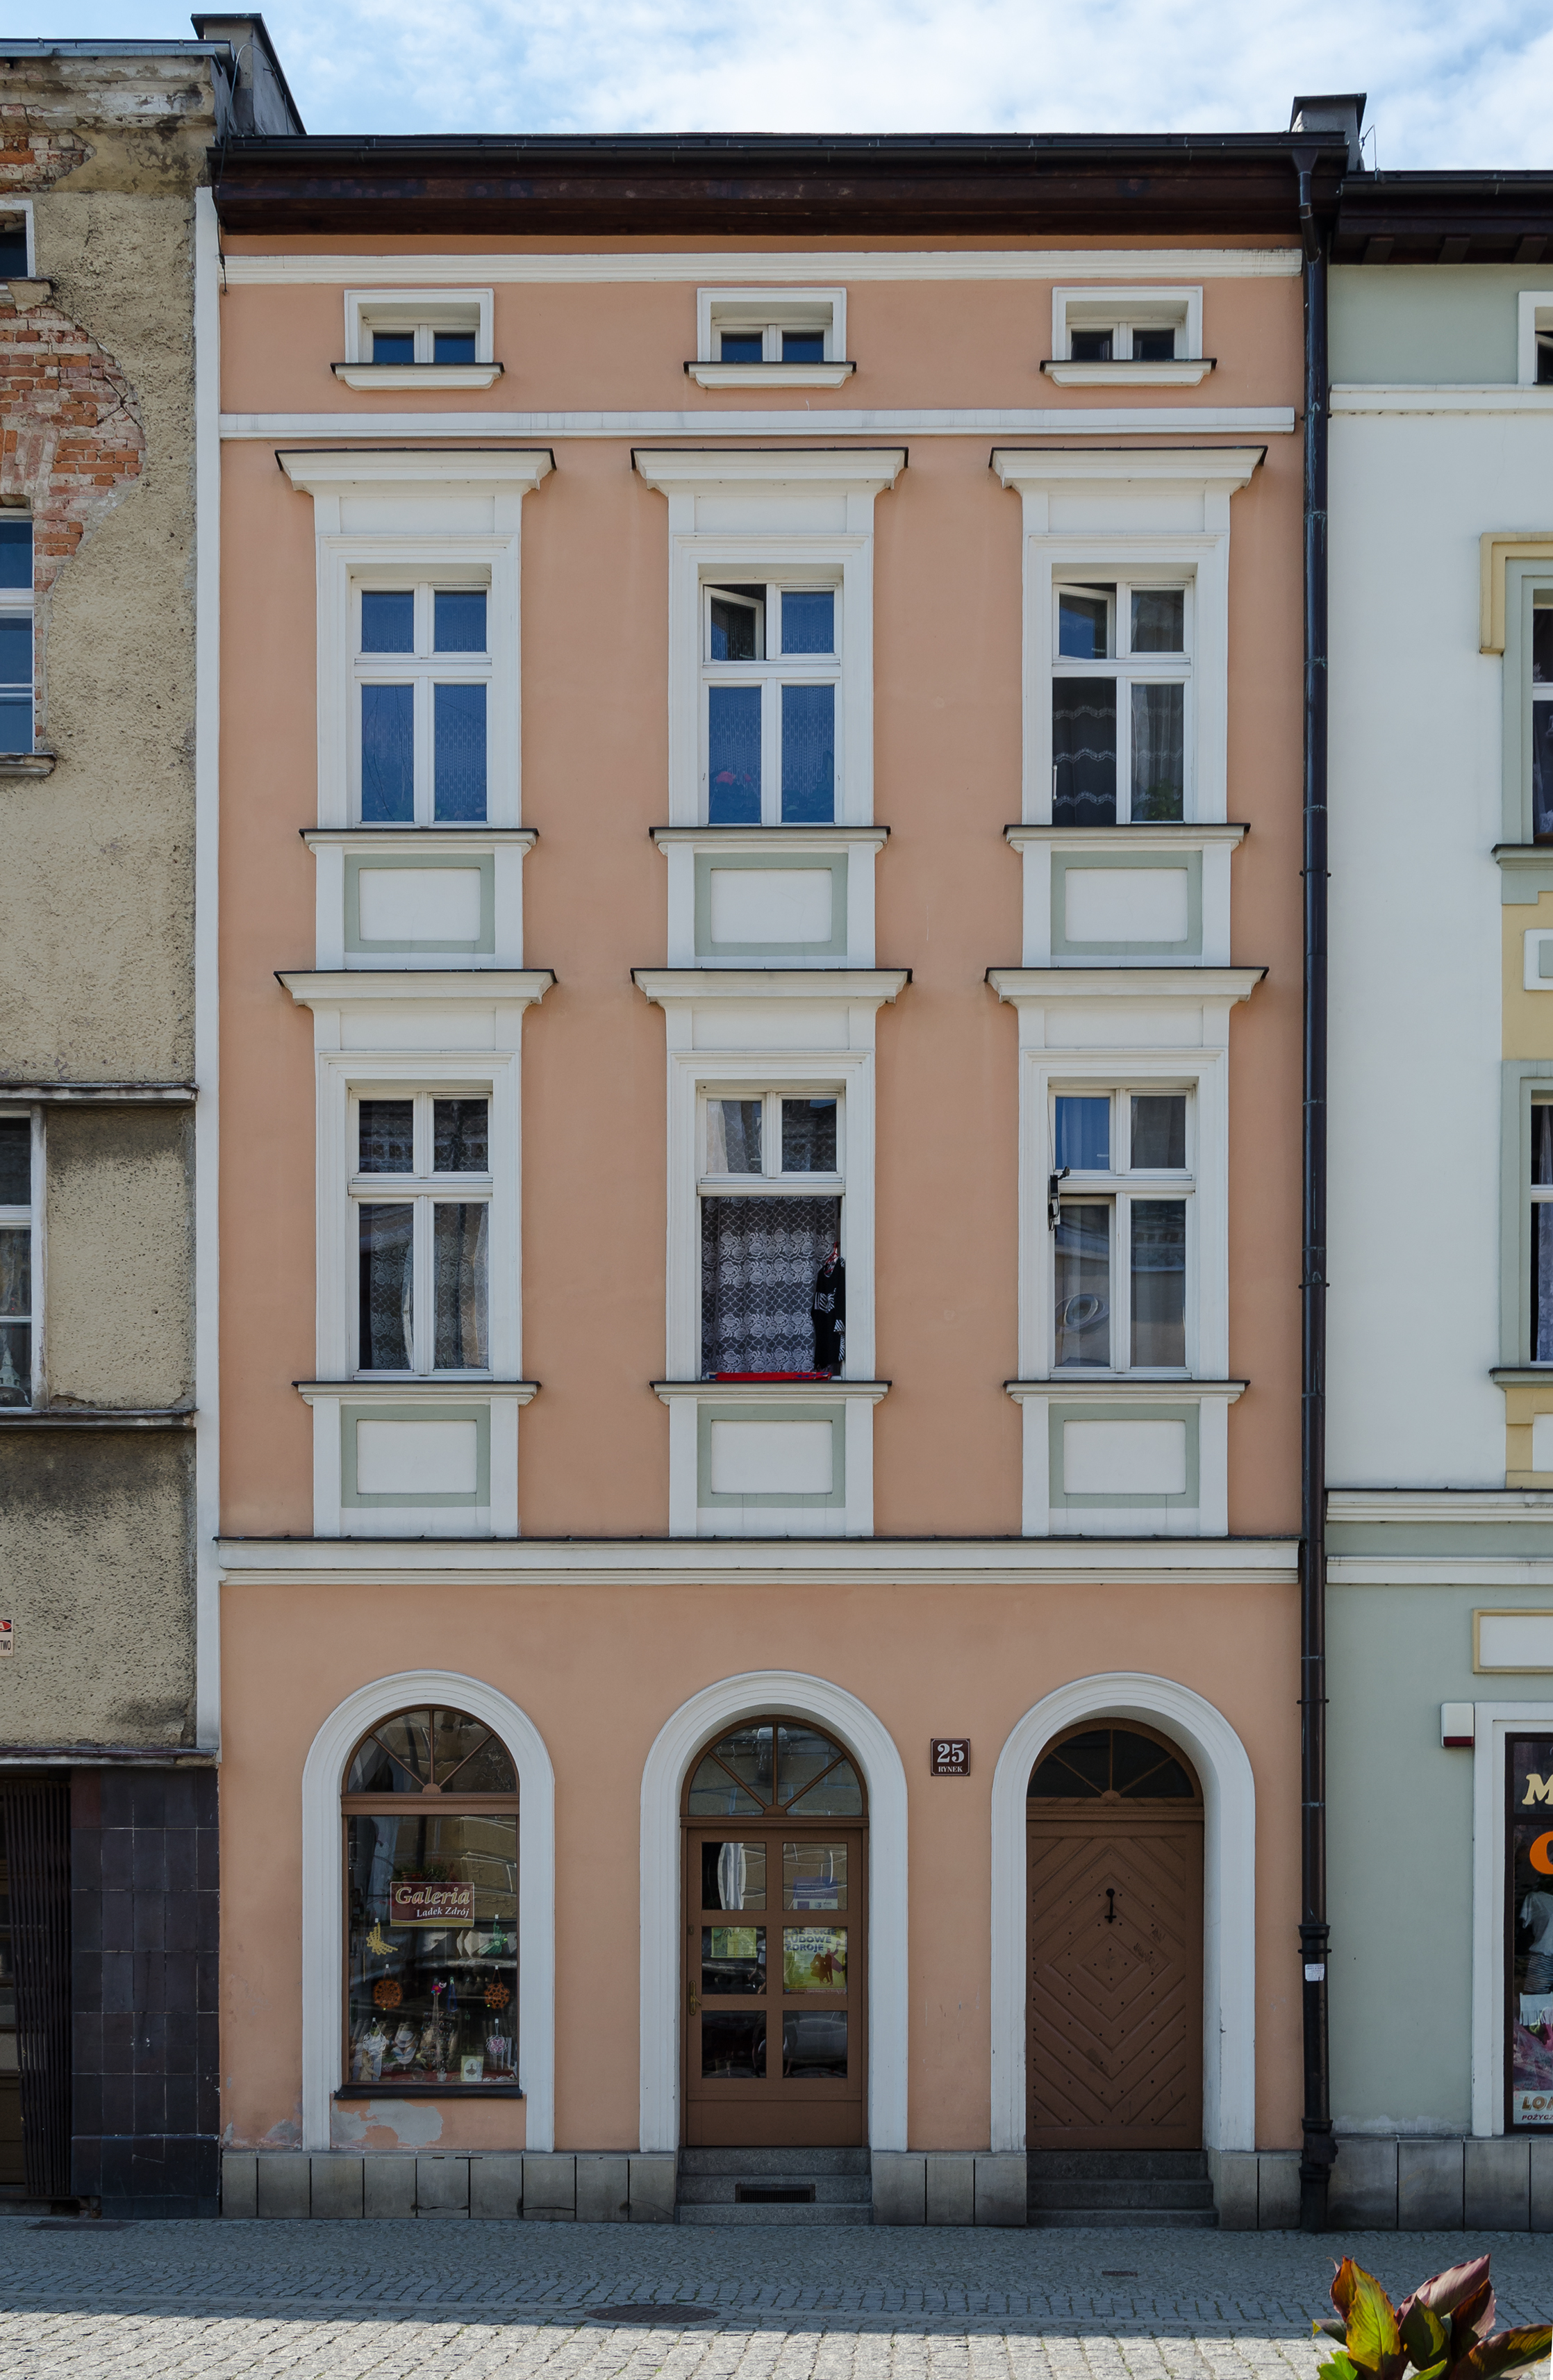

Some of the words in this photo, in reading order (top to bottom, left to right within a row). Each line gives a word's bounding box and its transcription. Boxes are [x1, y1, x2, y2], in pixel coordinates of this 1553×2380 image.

[937, 1743, 965, 1763] 25
[395, 1886, 470, 1904] Galeria
[445, 1907, 470, 1918] Zdrój
[784, 1935, 832, 1944] LUDOWE
[785, 1944, 824, 1953] ZDROJE
